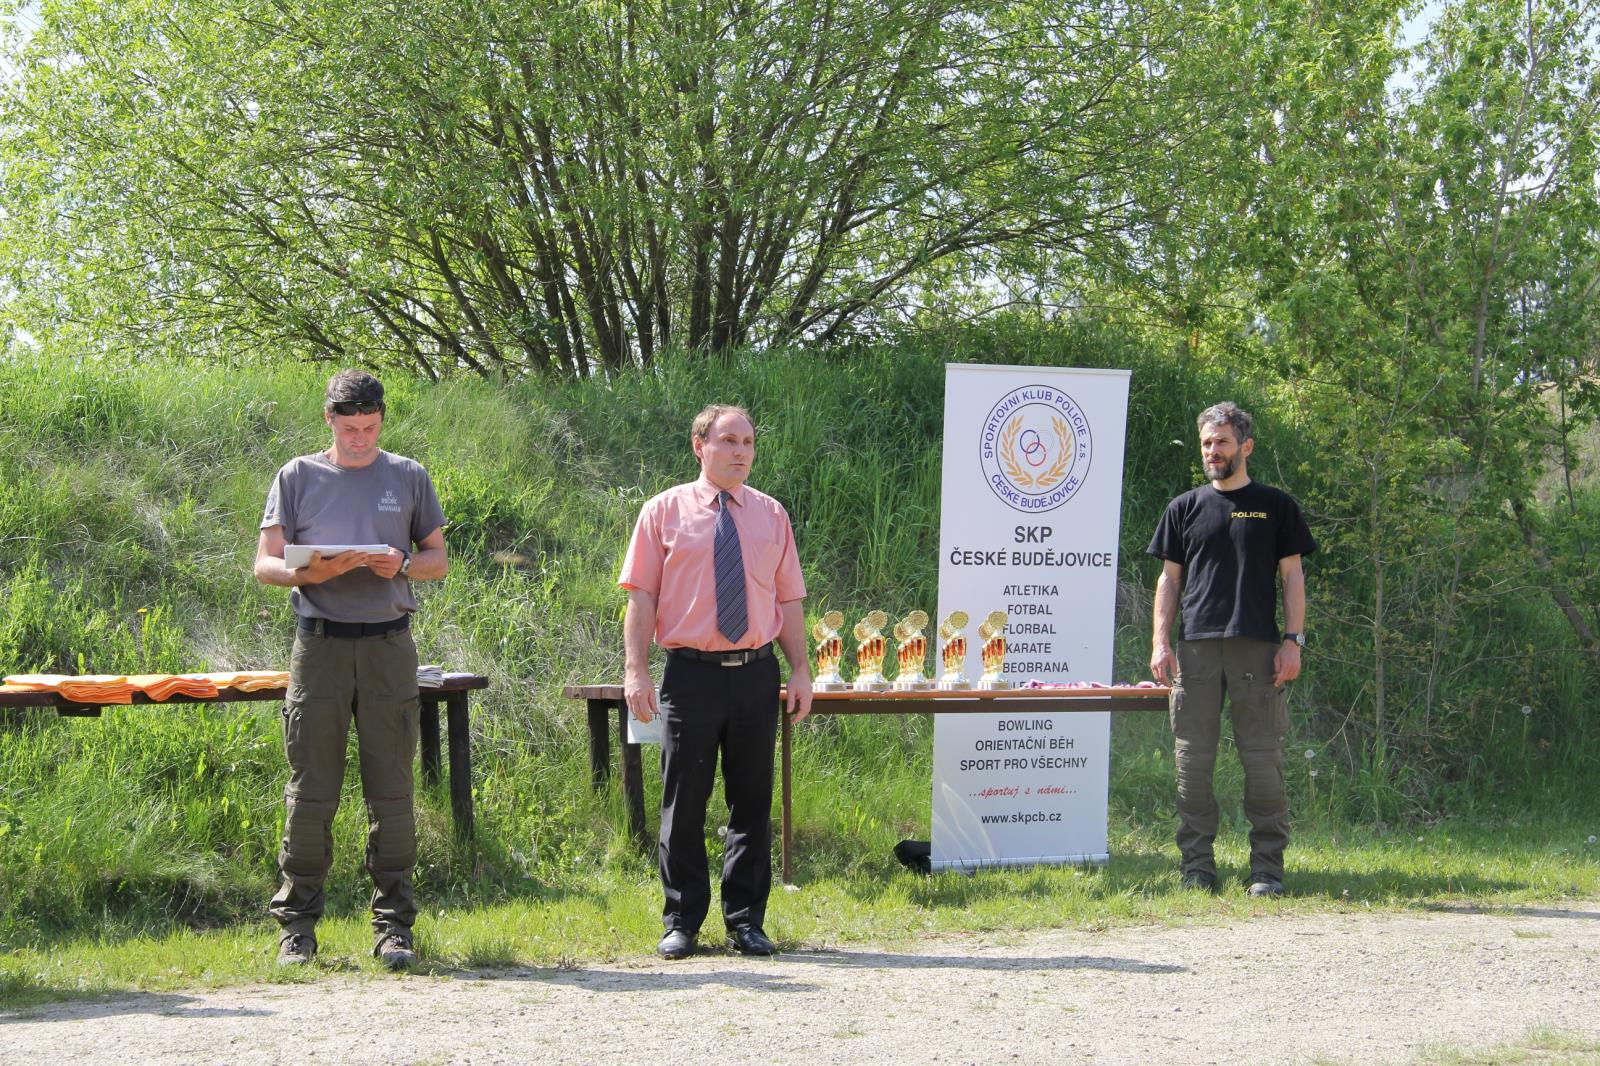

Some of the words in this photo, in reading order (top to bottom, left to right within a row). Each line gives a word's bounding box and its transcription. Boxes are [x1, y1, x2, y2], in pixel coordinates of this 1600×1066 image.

[1022, 389, 1053, 401] KLUB
[1055, 395, 1087, 437] POLICIE
[1231, 511, 1267, 519] POLICIE
[1014, 525, 1053, 543] SKP
[950, 547, 1007, 566] ČESKÉ
[1011, 548, 1112, 567] BUDĚJOVICE
[1003, 585, 1059, 596] ATLETIKA
[1007, 604, 1053, 615] FOTBAL
[1002, 623, 1056, 635] FLORBAL
[1005, 643, 1052, 654] KARATE
[1002, 662, 1069, 673] BEOBRANA
[998, 719, 1053, 731] BOWLING
[975, 736, 1047, 751] ORIENTAČNÍ
[1050, 737, 1074, 749] BĚH
[960, 759, 1001, 771] SPORT
[1004, 758, 1028, 770] PRO
[1030, 755, 1088, 769] VŠECHNY
[1024, 787, 1031, 795] s
[981, 812, 1062, 825] www.skpcb.cz
